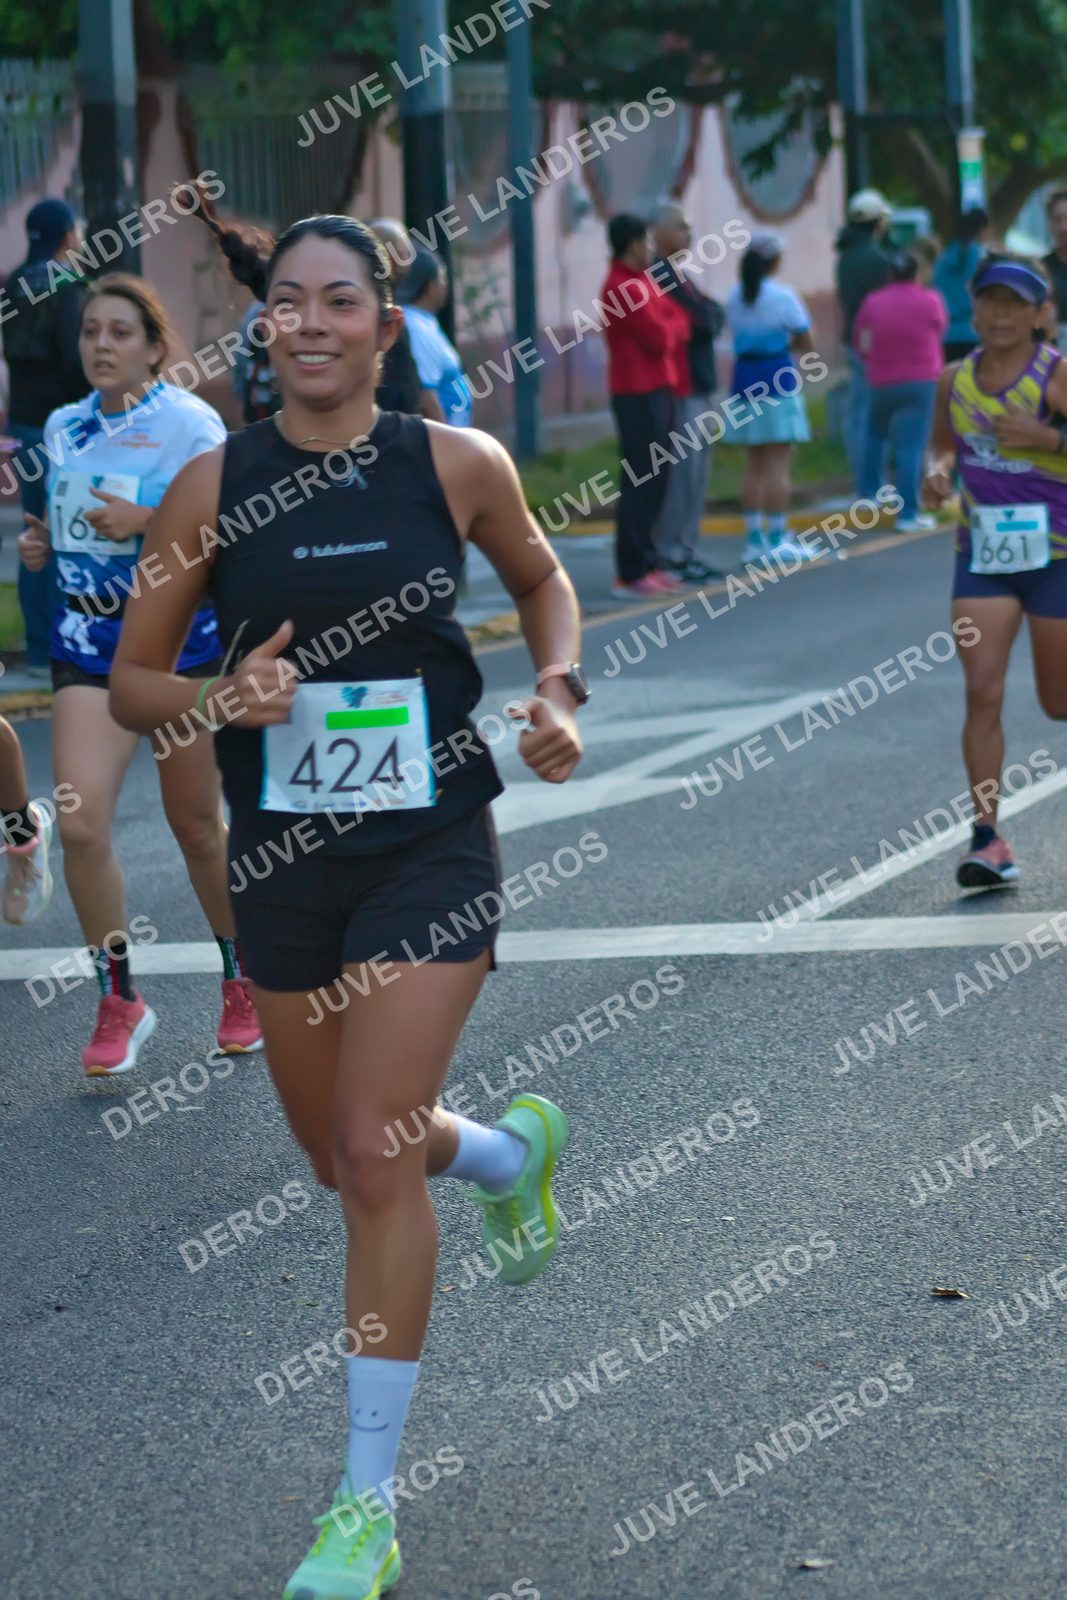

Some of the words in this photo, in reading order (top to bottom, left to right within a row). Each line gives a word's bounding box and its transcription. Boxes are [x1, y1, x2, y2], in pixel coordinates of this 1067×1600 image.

[55, 504, 108, 542] 16
[980, 535, 1029, 565] 661
[288, 735, 405, 794] 424
